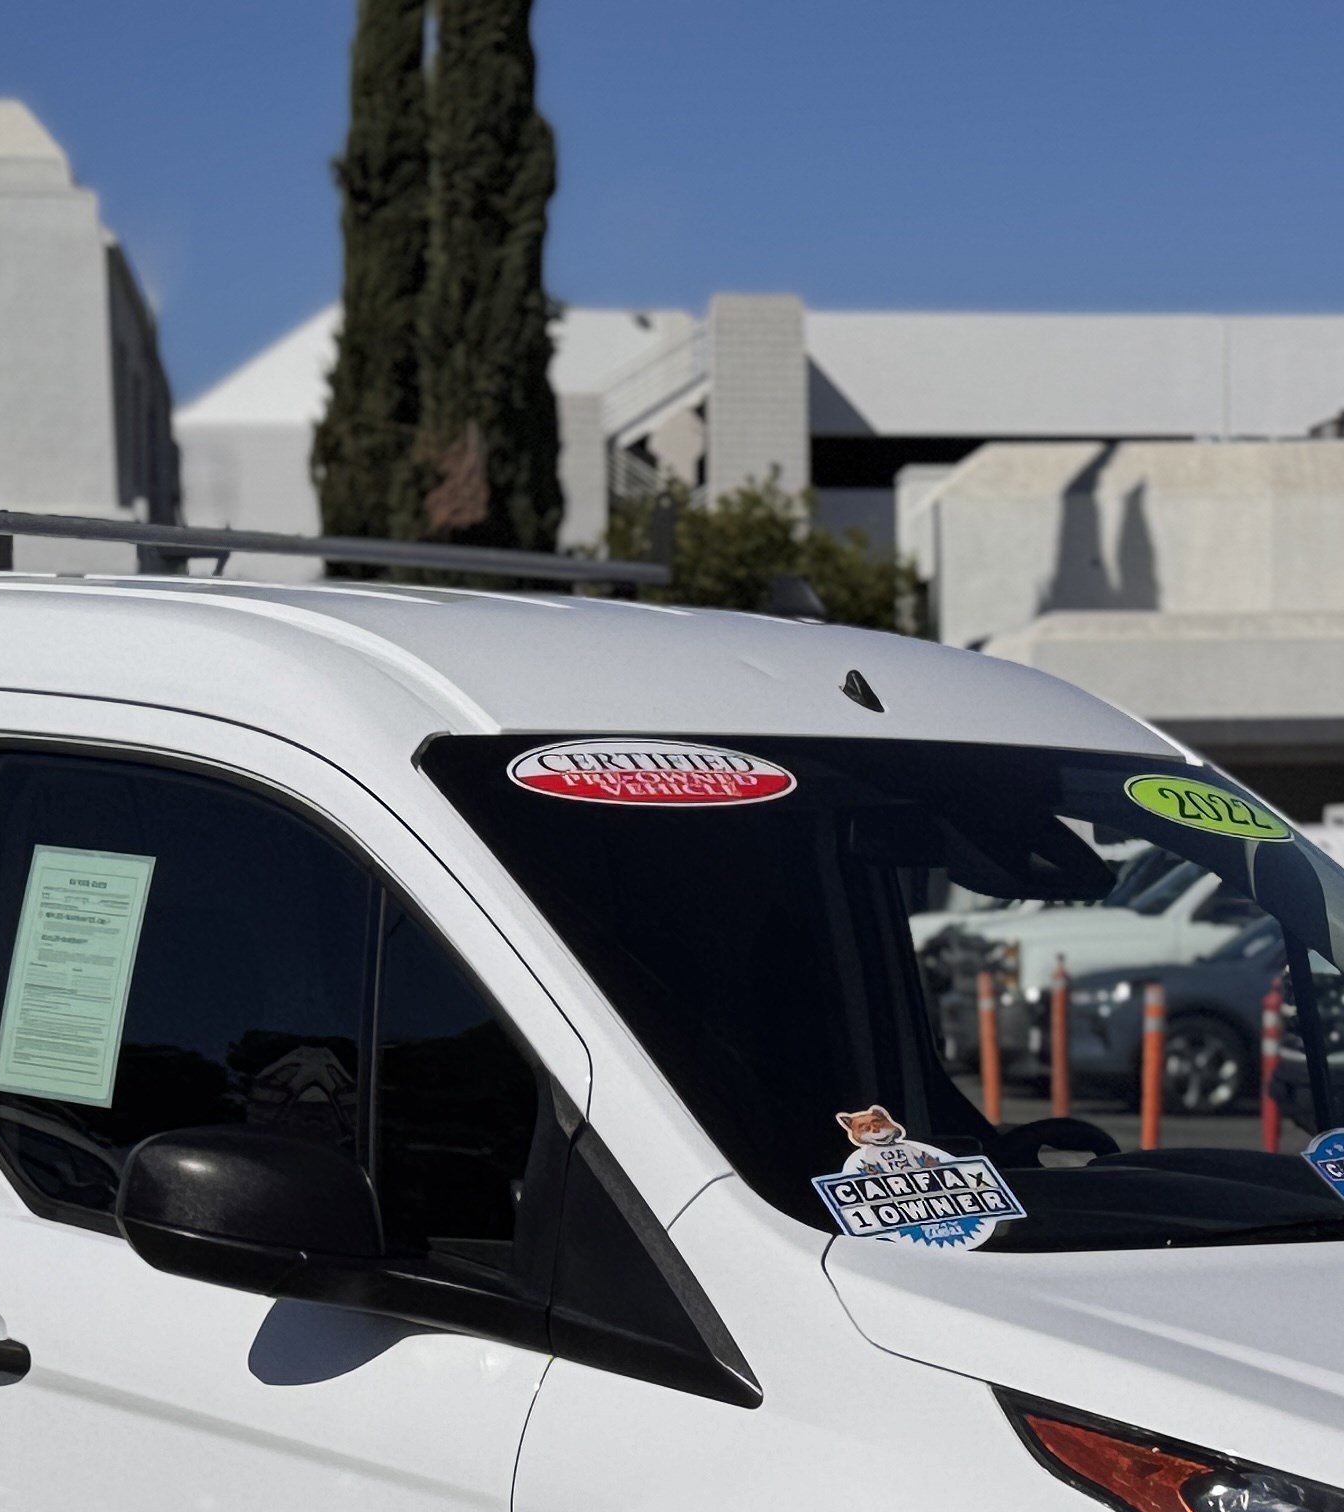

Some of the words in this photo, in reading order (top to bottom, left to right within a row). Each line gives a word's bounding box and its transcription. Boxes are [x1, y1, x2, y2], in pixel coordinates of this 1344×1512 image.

[537, 752, 755, 774] CERTIFIED
[561, 770, 759, 787] PRE-OWNED
[599, 781, 743, 797] VEHICLE
[1157, 787, 1273, 830] 2022
[834, 1169, 999, 1204] CARFAX
[877, 1193, 1007, 1225] OWNER
